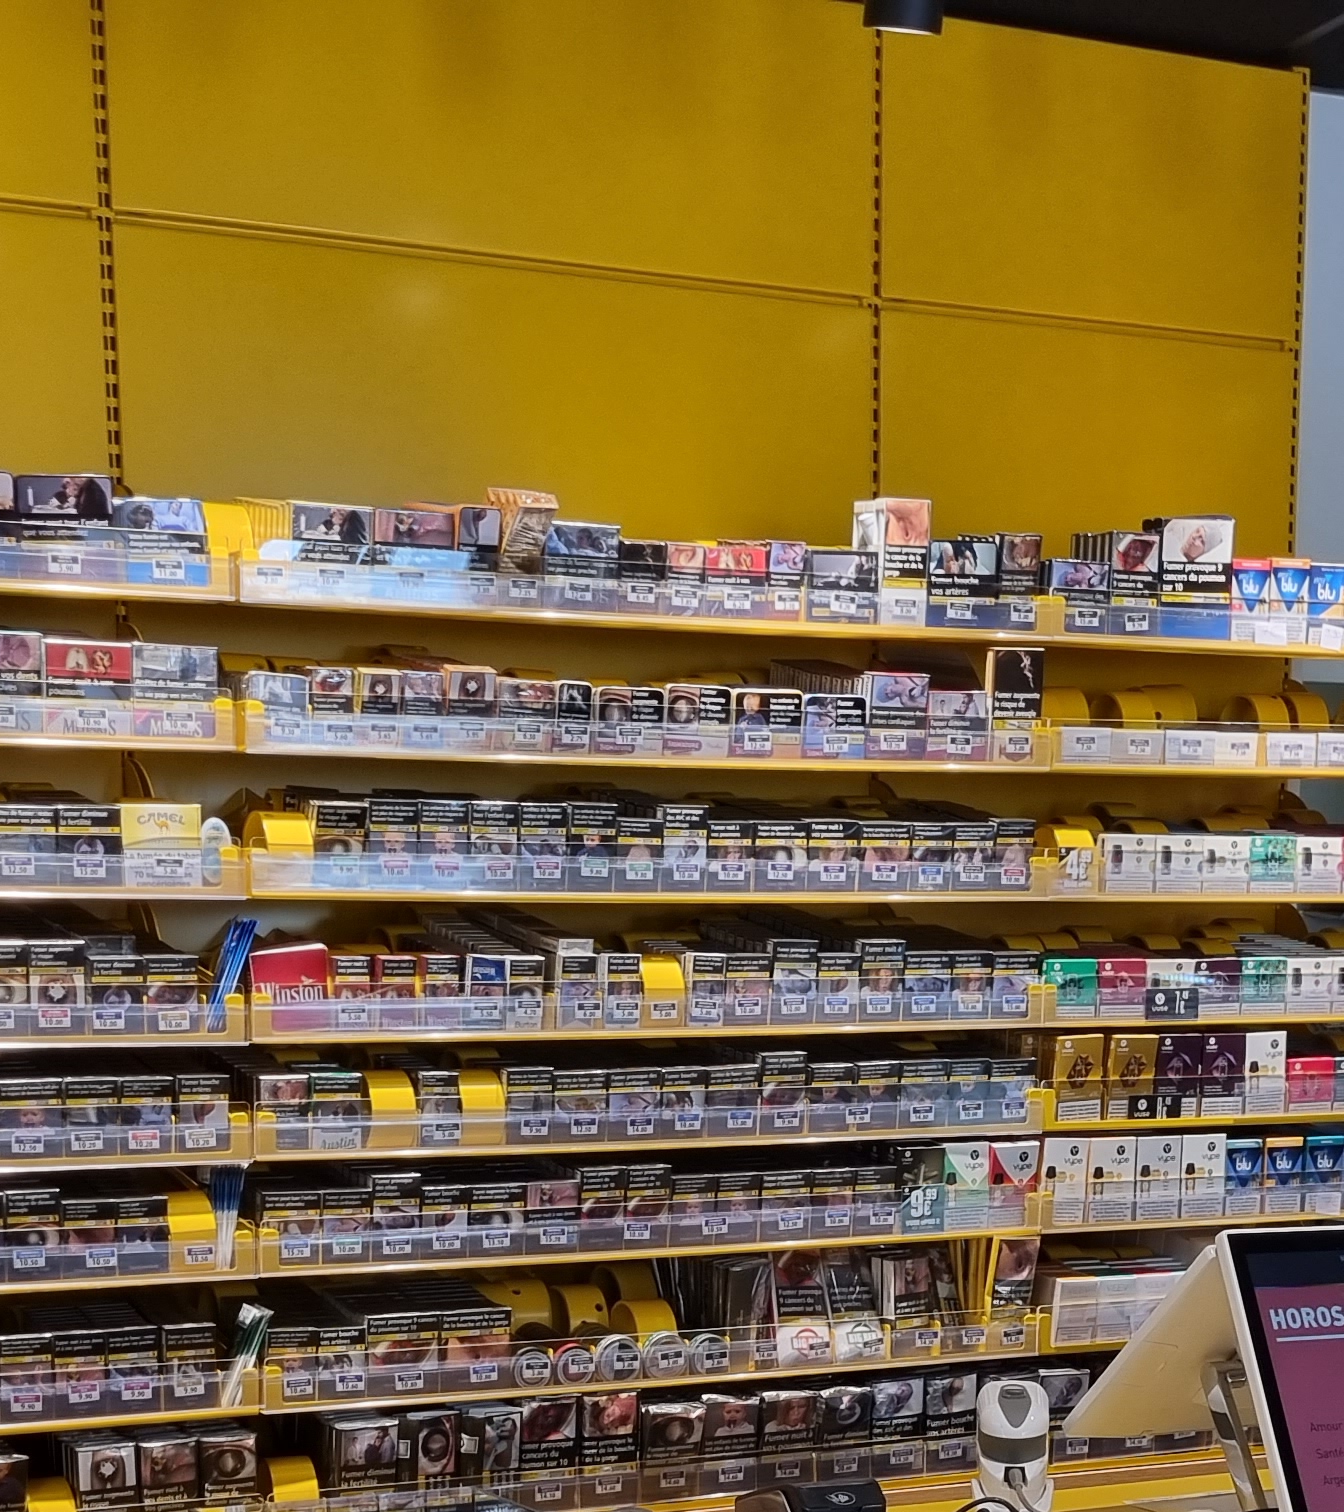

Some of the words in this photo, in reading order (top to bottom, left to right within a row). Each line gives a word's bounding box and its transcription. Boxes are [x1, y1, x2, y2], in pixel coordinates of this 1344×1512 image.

[1242, 579, 1259, 595] blu
[1281, 577, 1298, 593] blu
[1317, 583, 1336, 601] blu
[137, 811, 186, 825] CAMEL
[259, 982, 323, 1005] Winston
[320, 1136, 357, 1150] Austin
[1064, 1157, 1084, 1166] vype
[1236, 1157, 1252, 1172] blu
[1317, 1154, 1333, 1169] blu
[1310, 1422, 1343, 1433] Amour
